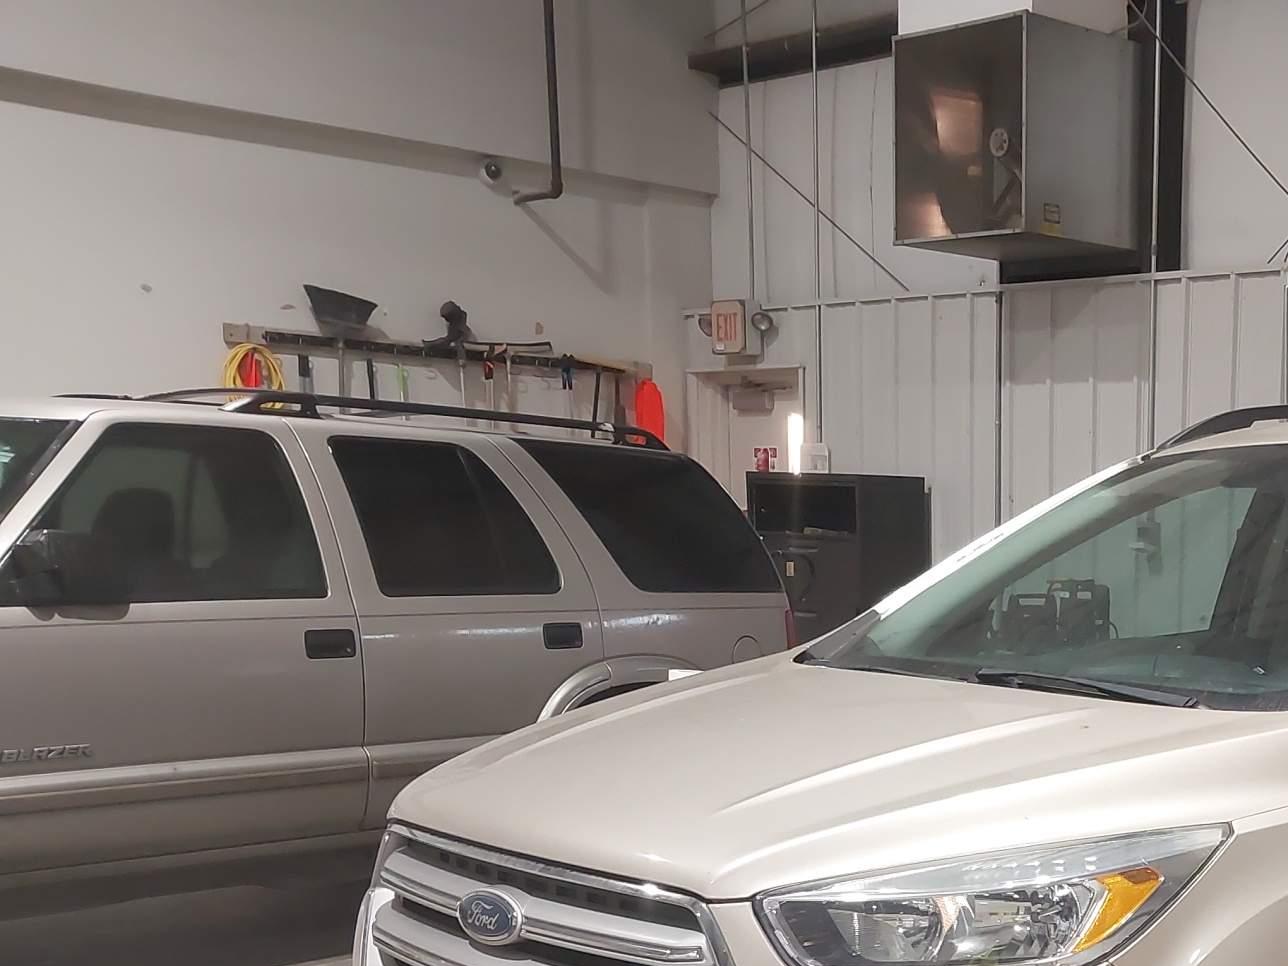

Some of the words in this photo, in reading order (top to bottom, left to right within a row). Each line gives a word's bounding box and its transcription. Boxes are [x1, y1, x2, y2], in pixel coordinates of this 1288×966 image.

[716, 311, 738, 342] EXIT
[1, 743, 94, 762] BLAZER
[467, 900, 500, 930] Ford
